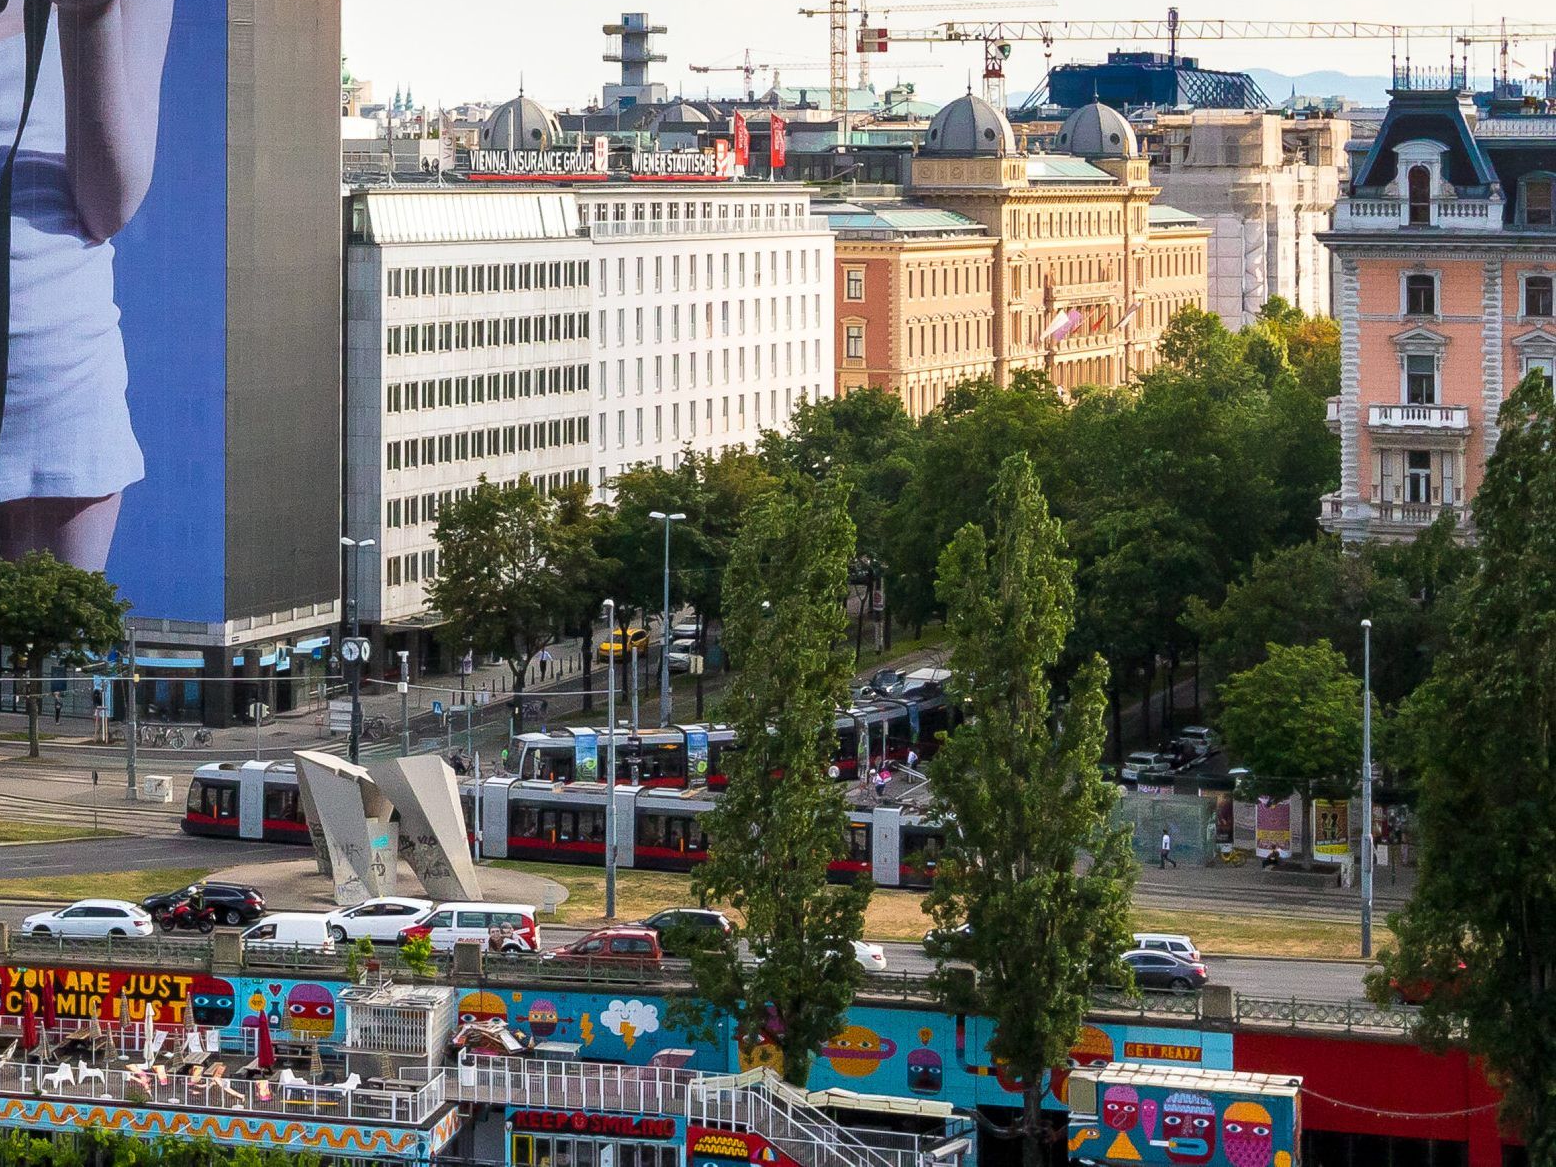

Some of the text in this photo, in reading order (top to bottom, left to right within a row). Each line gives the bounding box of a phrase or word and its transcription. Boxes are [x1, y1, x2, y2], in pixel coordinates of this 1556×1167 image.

[470, 150, 594, 172] VIENNA INSURANCE GROUP
[632, 152, 666, 172] WIENER
[65, 971, 111, 994] ARE
[124, 974, 194, 999] JUST
[1126, 1043, 1199, 1061] GET READY
[514, 1110, 676, 1138] KEEP SMILING
